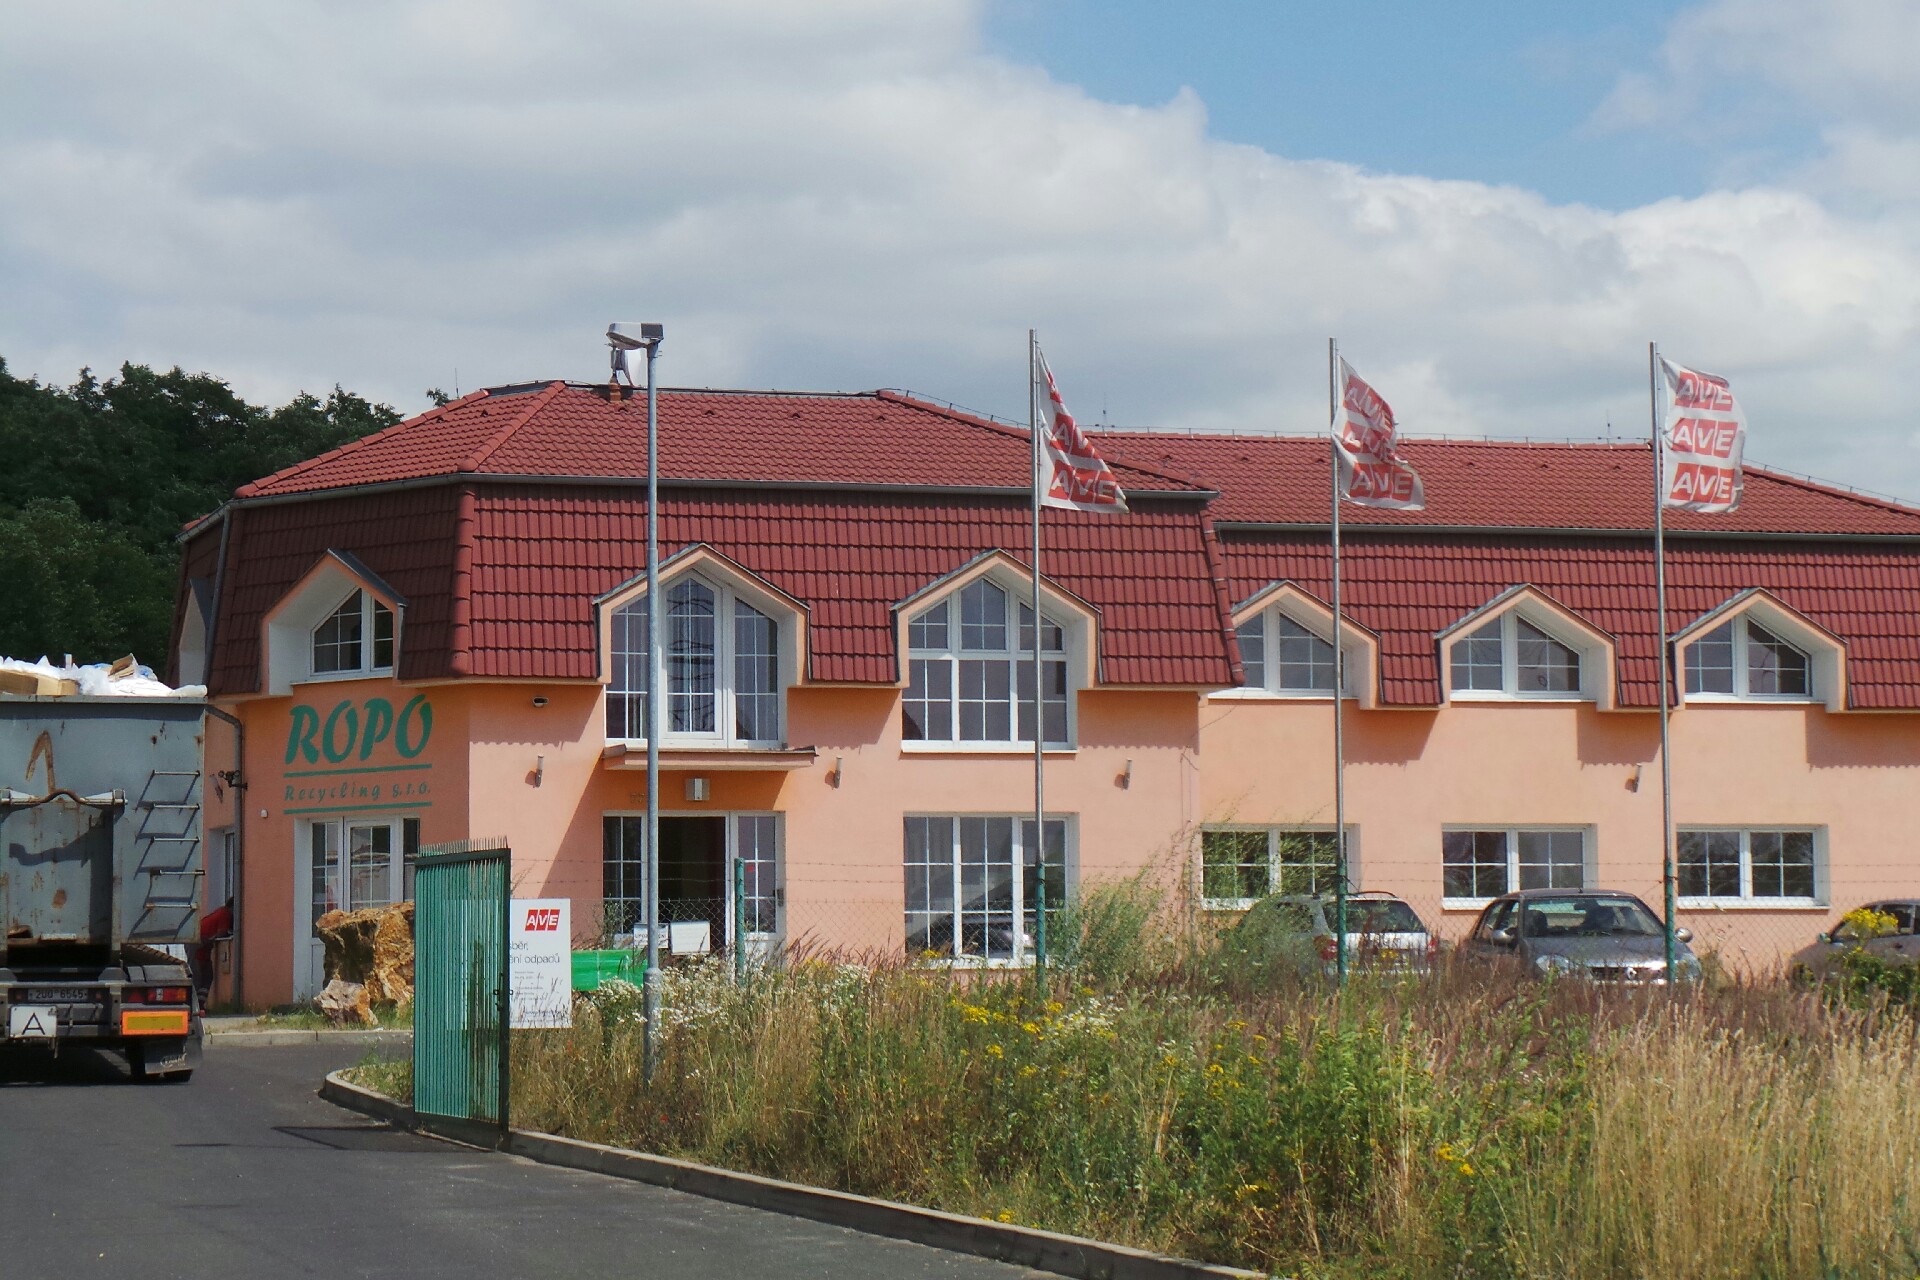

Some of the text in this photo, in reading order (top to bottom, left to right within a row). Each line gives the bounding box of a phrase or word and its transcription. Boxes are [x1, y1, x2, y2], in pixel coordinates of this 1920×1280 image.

[1676, 378, 1732, 404] AVE
[1673, 424, 1734, 452] AVE
[1050, 468, 1117, 498] AVE
[1351, 471, 1411, 495] AVE
[1671, 471, 1732, 499] AVE
[285, 693, 433, 765] ROPO
[284, 780, 431, 803] Recycling s.r.o.
[524, 953, 560, 965] odpadů
[59, 989, 83, 999] 6545
[22, 1012, 45, 1035] A
